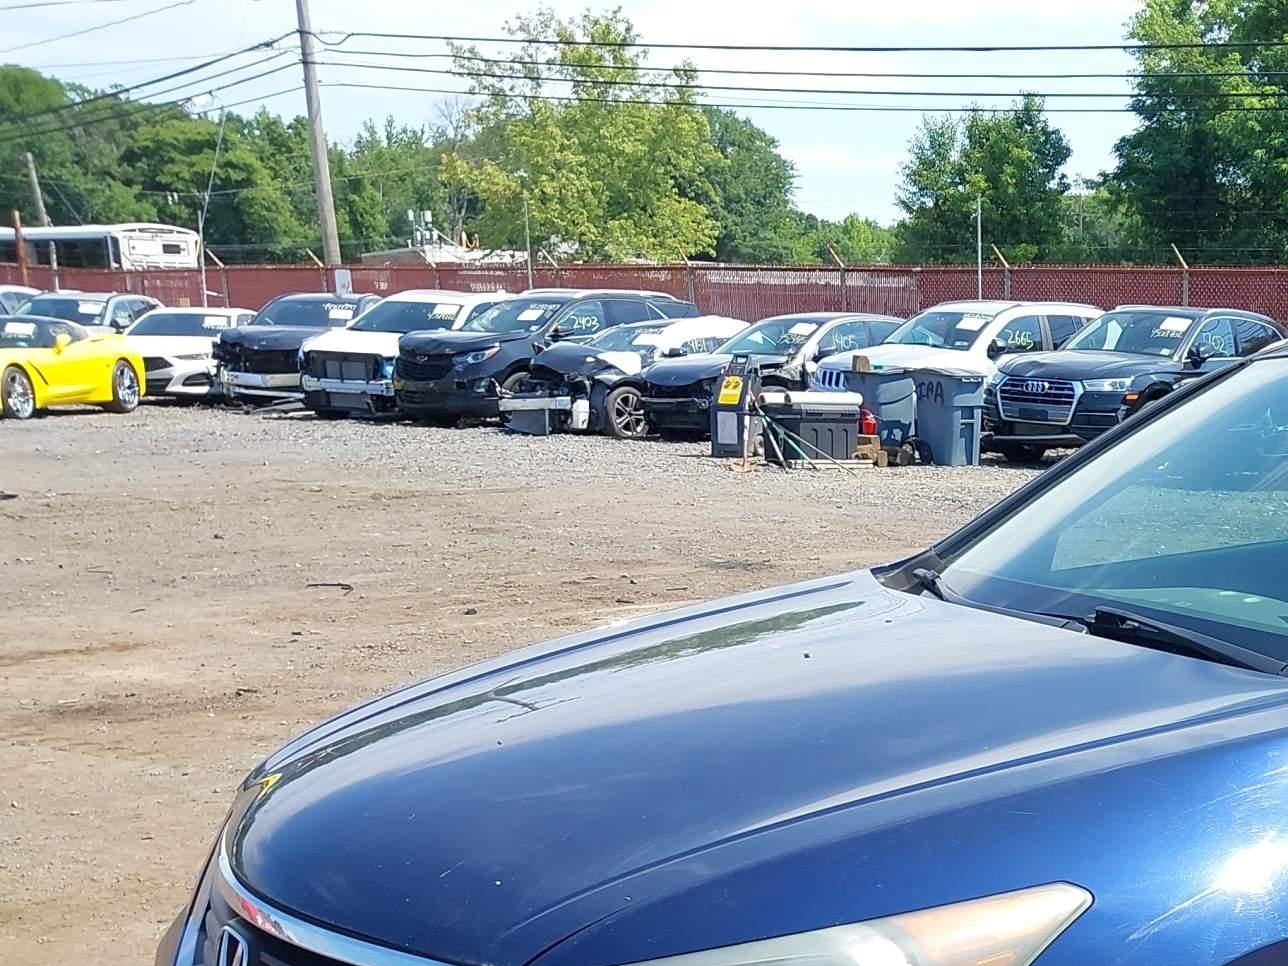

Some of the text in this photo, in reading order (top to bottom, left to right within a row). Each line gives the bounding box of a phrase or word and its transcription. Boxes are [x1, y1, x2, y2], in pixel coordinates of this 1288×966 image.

[570, 315, 600, 332] 2403
[833, 328, 859, 350] 1405
[1004, 329, 1034, 350] 2665
[917, 380, 944, 403] IAA
